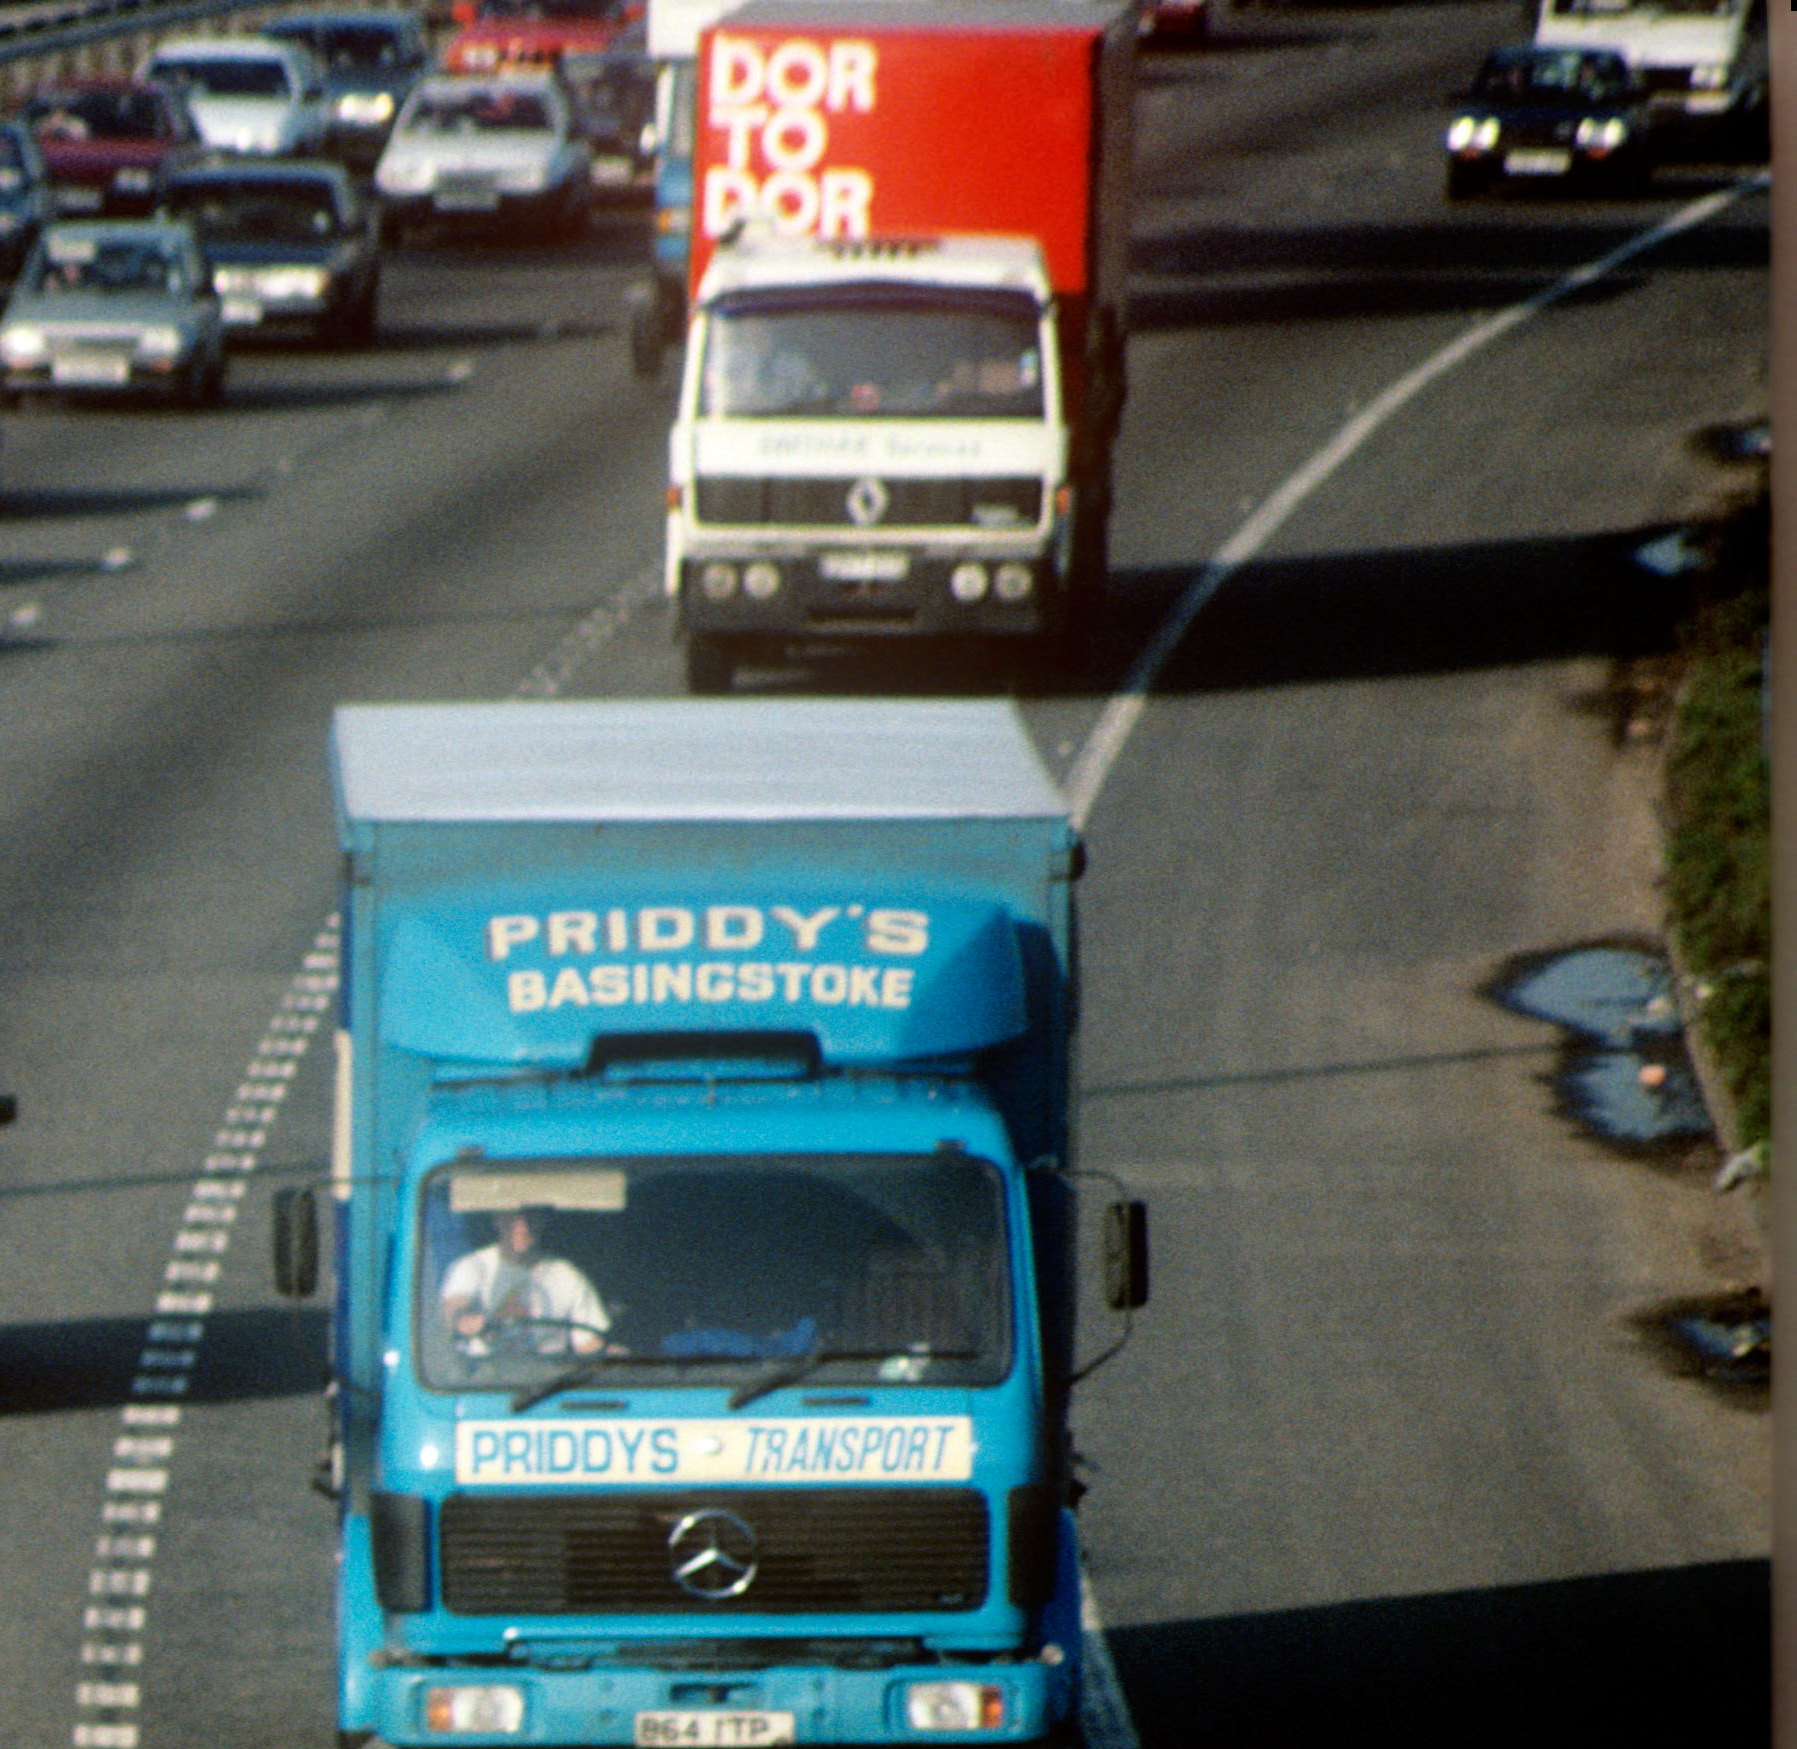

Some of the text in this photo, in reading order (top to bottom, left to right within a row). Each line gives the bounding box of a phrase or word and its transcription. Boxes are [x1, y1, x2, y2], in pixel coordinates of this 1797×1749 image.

[708, 32, 878, 113] DOR
[709, 103, 828, 172] TO
[704, 164, 873, 239] DOR
[488, 903, 930, 961] PRIDDY'S
[507, 961, 916, 1013] BASINGSTOKE
[471, 1424, 955, 1474] PRIDDYS TRANSPORT
